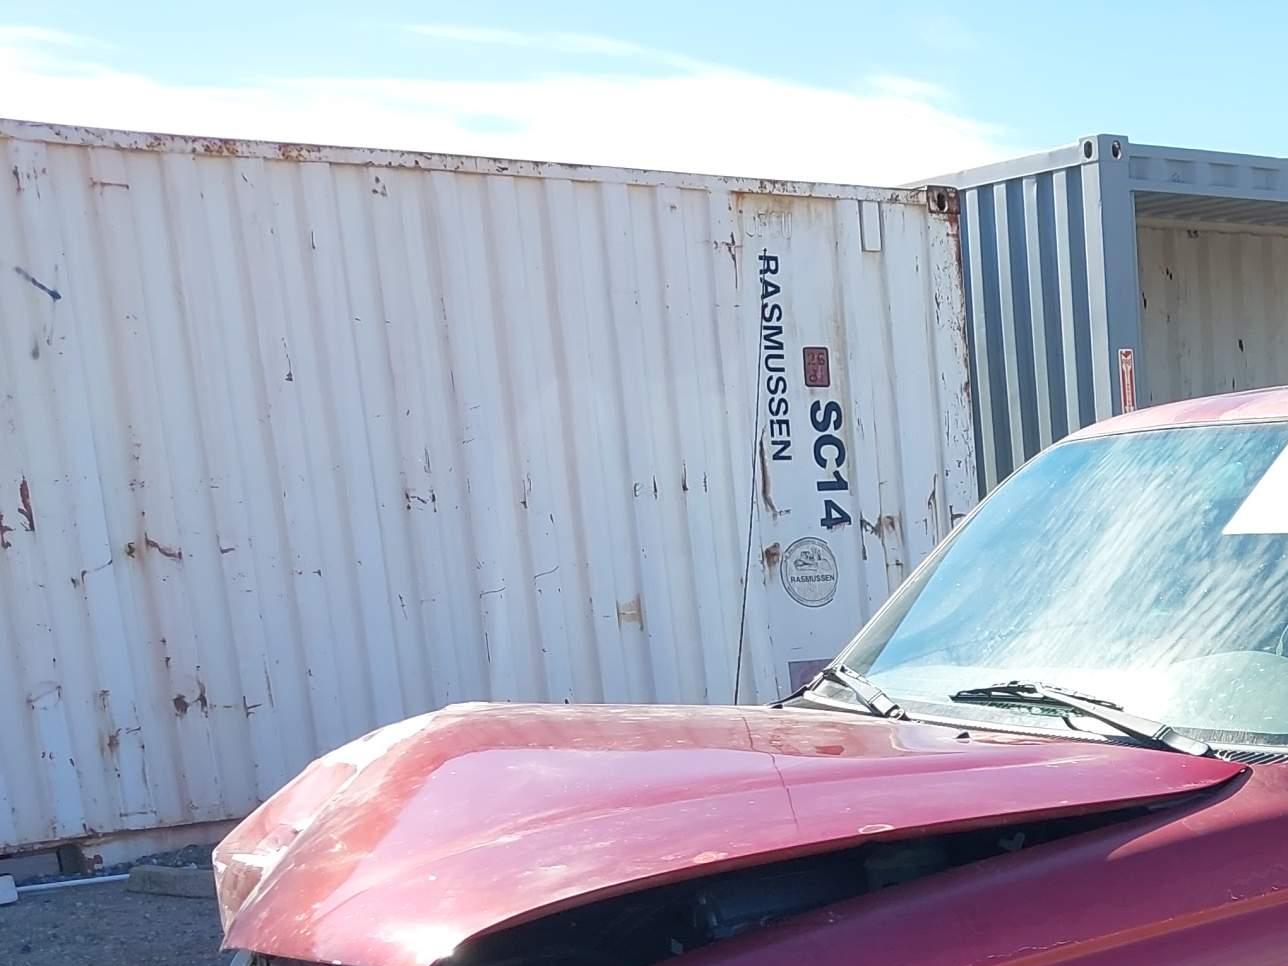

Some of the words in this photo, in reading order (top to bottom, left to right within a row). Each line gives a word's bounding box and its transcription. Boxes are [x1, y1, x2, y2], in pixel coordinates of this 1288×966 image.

[758, 252, 793, 462] RASMUSSEN
[810, 400, 852, 529] SC14
[790, 574, 835, 583] RASMUSSEN
